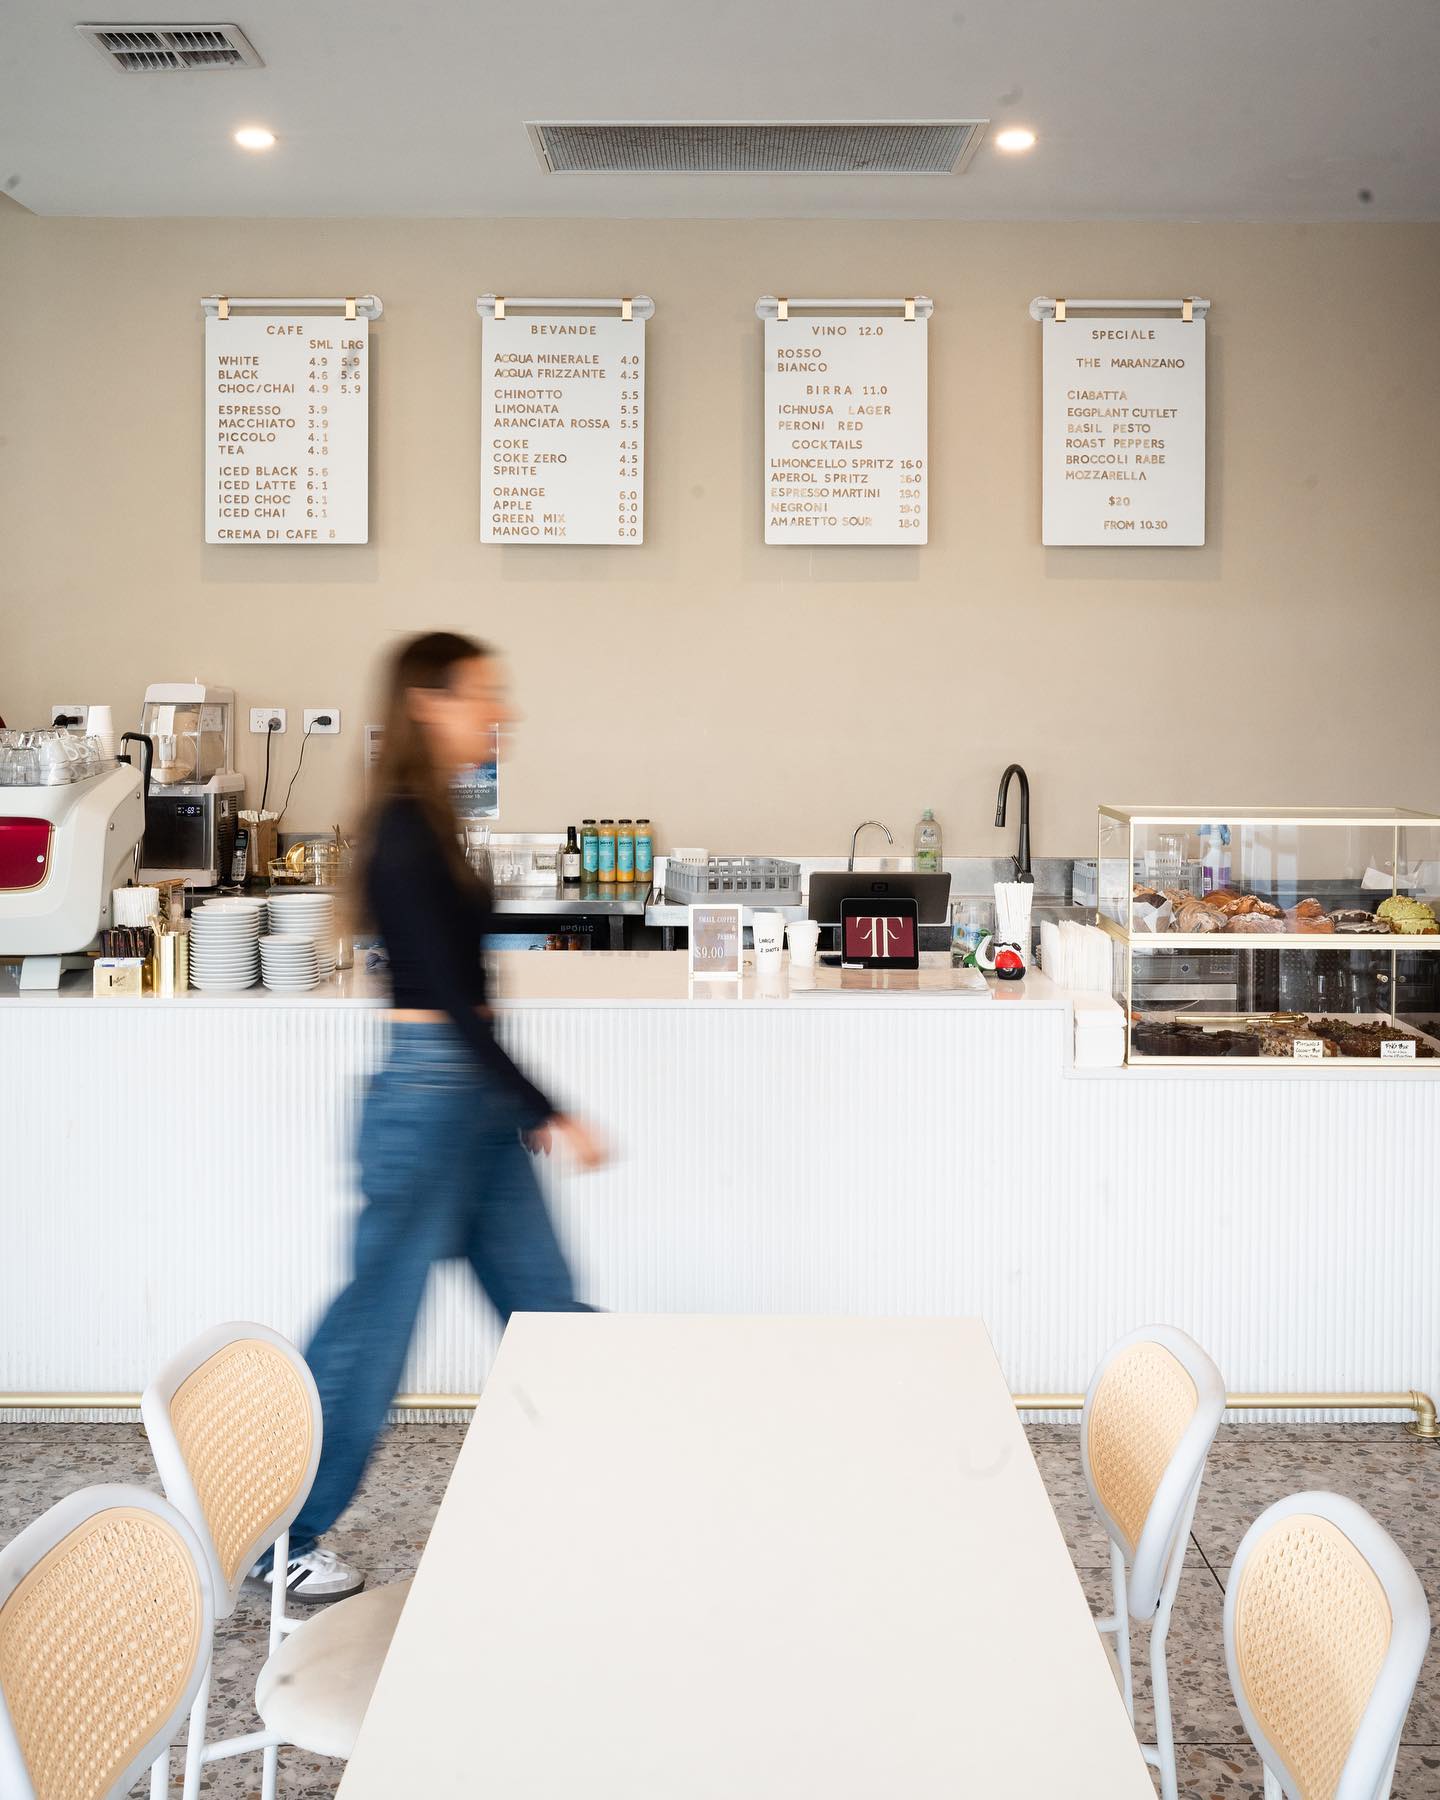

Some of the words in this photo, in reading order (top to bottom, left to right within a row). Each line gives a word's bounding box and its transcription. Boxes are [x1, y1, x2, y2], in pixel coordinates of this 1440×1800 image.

[266, 325, 304, 335] CAFE
[531, 325, 597, 335] BEVANDE
[812, 326, 847, 336] VINO
[858, 326, 884, 336] 12.0
[1092, 330, 1155, 340] SPECIALE
[309, 339, 333, 350] SML
[341, 339, 364, 350] LRG
[777, 348, 822, 358] ROSSO
[218, 356, 259, 366] WHITE
[309, 357, 328, 367] 4.9
[341, 357, 360, 367] 5.9
[494, 353, 534, 364] ACQUA
[537, 354, 599, 364] MINERALE
[620, 355, 639, 365] 4.0
[1076, 358, 1101, 368] THE
[1110, 358, 1185, 369] MARANZANO
[777, 362, 828, 373] BIANCO
[218, 370, 258, 380] BLACK
[308, 371, 328, 380] 4.6
[341, 370, 361, 380] 5.6
[494, 368, 534, 379] ACQUA
[537, 369, 606, 378] FRIZZANTE
[620, 370, 639, 380] 4.5
[218, 383, 295, 393] CHOC/CHAI
[308, 384, 329, 394] 4.9
[340, 384, 361, 394] 5.9
[806, 385, 853, 395] BIRRA
[863, 385, 888, 395] 11.0
[494, 389, 563, 399] CHINOTTO
[621, 391, 639, 400] 5.5
[1067, 390, 1128, 401] CIABATTA
[218, 405, 281, 415] ESPRESSO
[308, 405, 328, 415] 3.9
[495, 404, 559, 414] LIMONATA
[620, 405, 639, 415] 5.5
[778, 404, 834, 415] ICHNUSA
[848, 405, 891, 415] LAGER
[1067, 407, 1129, 418] EGGPLANT
[1132, 408, 1178, 419] CUTLET
[218, 419, 296, 429] MACCHIATO
[308, 419, 329, 428] 3.9
[494, 418, 565, 428] ARANCIATA
[570, 419, 610, 429] ROSSA
[620, 419, 639, 429] 5.5
[778, 421, 824, 431] PERONI
[838, 421, 864, 431] RED
[1067, 423, 1102, 434] BASIL
[1112, 423, 1151, 433] PESTO
[218, 432, 276, 442] PICCOLO
[308, 432, 329, 442] 4.1
[493, 439, 529, 449] COKE
[619, 441, 638, 450] 4.5
[791, 439, 863, 450] COCKTAILS
[1065, 438, 1106, 448] ROAST
[1113, 439, 1165, 449] PEPPERS
[218, 445, 245, 455] TEA
[307, 446, 329, 456] 4.8
[493, 453, 529, 463] COKE
[534, 454, 567, 463] ZERO
[619, 454, 638, 464] 4.5
[771, 458, 847, 469] LIMONCELLO
[852, 459, 894, 469] SPRITZ
[1065, 454, 1128, 465] BROCCOLI
[1135, 454, 1166, 464] RABE
[219, 467, 250, 476] ICED
[256, 466, 298, 476] BLACK
[307, 467, 329, 477] 5.6
[493, 466, 537, 476] SPRITE
[619, 467, 638, 477] 4.5
[1065, 471, 1147, 481] MOZZARELLA
[771, 473, 818, 483] APEROL
[824, 473, 868, 484] SPRITZ
[219, 480, 250, 490] ICED
[256, 480, 296, 490] LATTE
[306, 481, 328, 490] 6.1
[493, 487, 546, 497] ORANGE
[619, 491, 637, 500] 6.0
[771, 488, 829, 497] ESPRESSO
[832, 488, 880, 498] MARTINI
[218, 495, 250, 504] ICED
[254, 495, 291, 504] CHOC
[306, 495, 328, 505] 6.1
[1108, 496, 1130, 506] $20
[493, 501, 532, 510] APPLE
[618, 502, 638, 512] 6.0
[771, 503, 828, 512] NEGRONI
[218, 508, 250, 518] ICED
[254, 508, 285, 518] CHAI
[306, 508, 328, 518] 6.1
[492, 514, 534, 523] GREEN
[543, 514, 567, 523] MIX
[618, 514, 637, 524] 6.0
[770, 516, 837, 527] AMARETTO
[842, 516, 872, 526] SOUR
[1103, 520, 1135, 530] FROM
[1140, 520, 1168, 530] 10.30
[218, 529, 261, 539] CREMA
[266, 529, 279, 539] DI
[286, 529, 318, 539] CAFE
[492, 526, 540, 536] MANGO
[544, 526, 567, 536] MIX
[618, 527, 637, 537] 6.0
